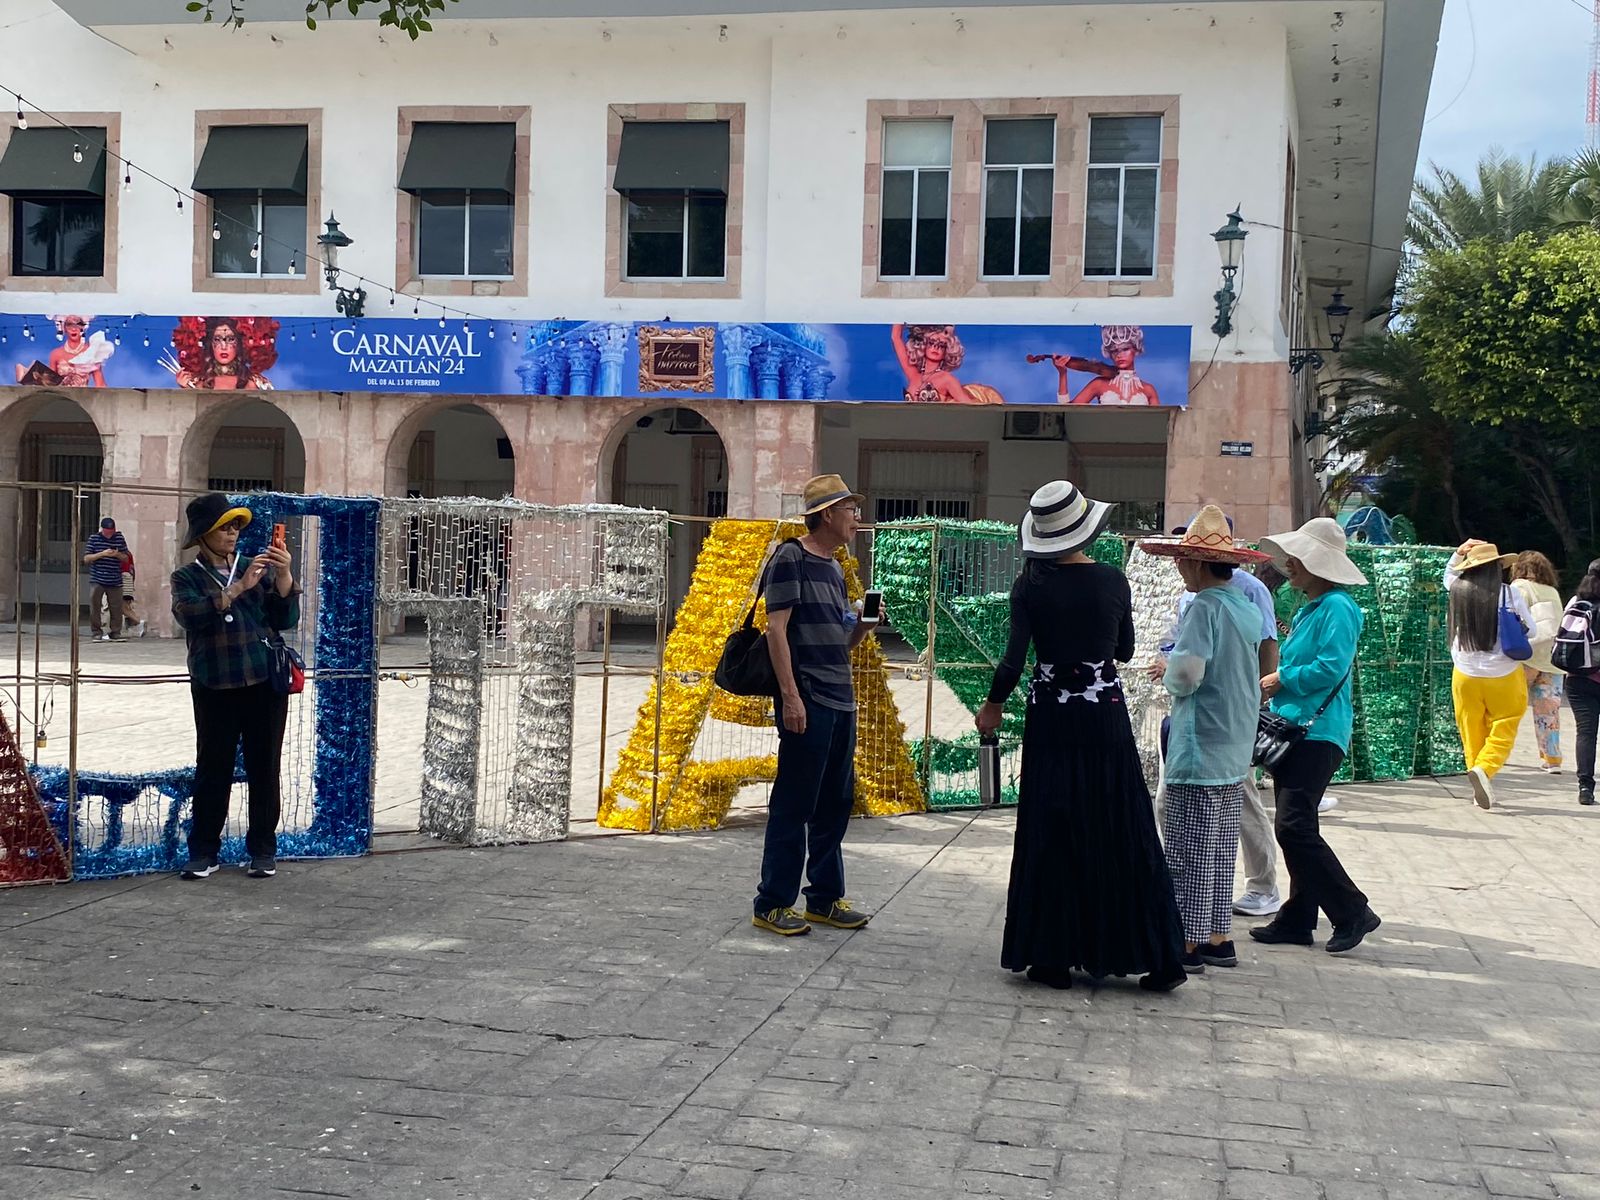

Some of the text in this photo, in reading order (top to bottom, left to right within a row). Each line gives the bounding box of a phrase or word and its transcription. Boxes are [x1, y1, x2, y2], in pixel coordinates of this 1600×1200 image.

[332, 329, 482, 357] CARNAVAL
[367, 378, 379, 386] DEL
[405, 379, 414, 387] DE
[414, 379, 440, 387] FEBRERO
